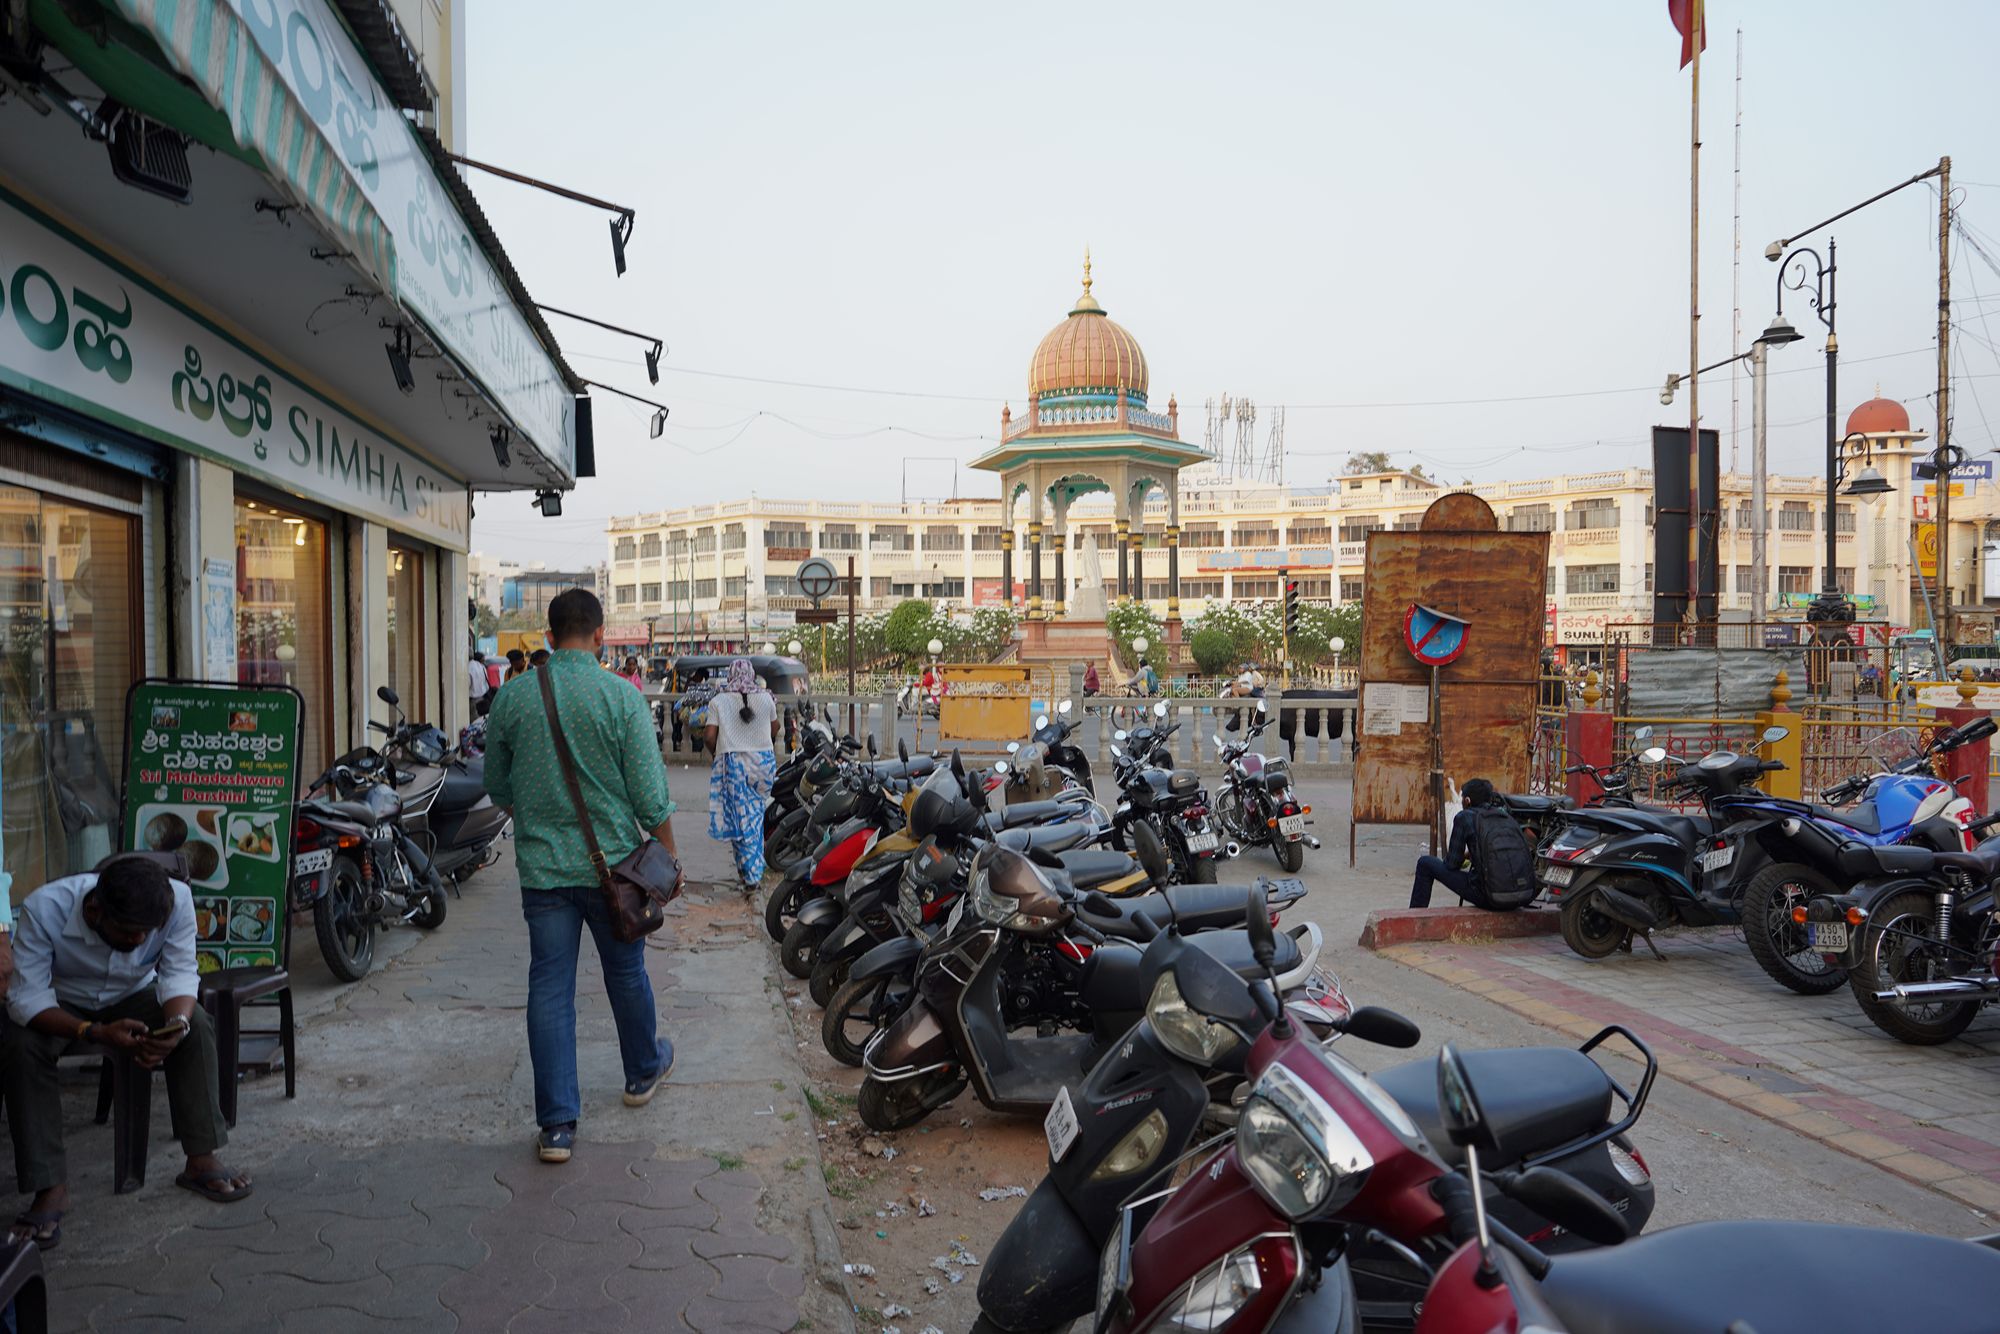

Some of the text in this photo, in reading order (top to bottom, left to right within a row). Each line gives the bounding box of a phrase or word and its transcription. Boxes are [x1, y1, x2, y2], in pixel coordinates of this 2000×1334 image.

[489, 303, 542, 415] SIMHA
[288, 404, 463, 535] SIMHA SILK
[1340, 546, 1356, 555] STAR
[1564, 631, 1631, 639] SUNLIGHT
[141, 728, 284, 761] ಶ್ರೀ ಮಹದೇಶ್ವರ
[163, 750, 233, 770] ದರ್ಶಿನಿ
[165, 770, 285, 787] Mahadeshwara
[182, 787, 248, 804] Darshini
[1134, 1090, 1154, 1103] 125
